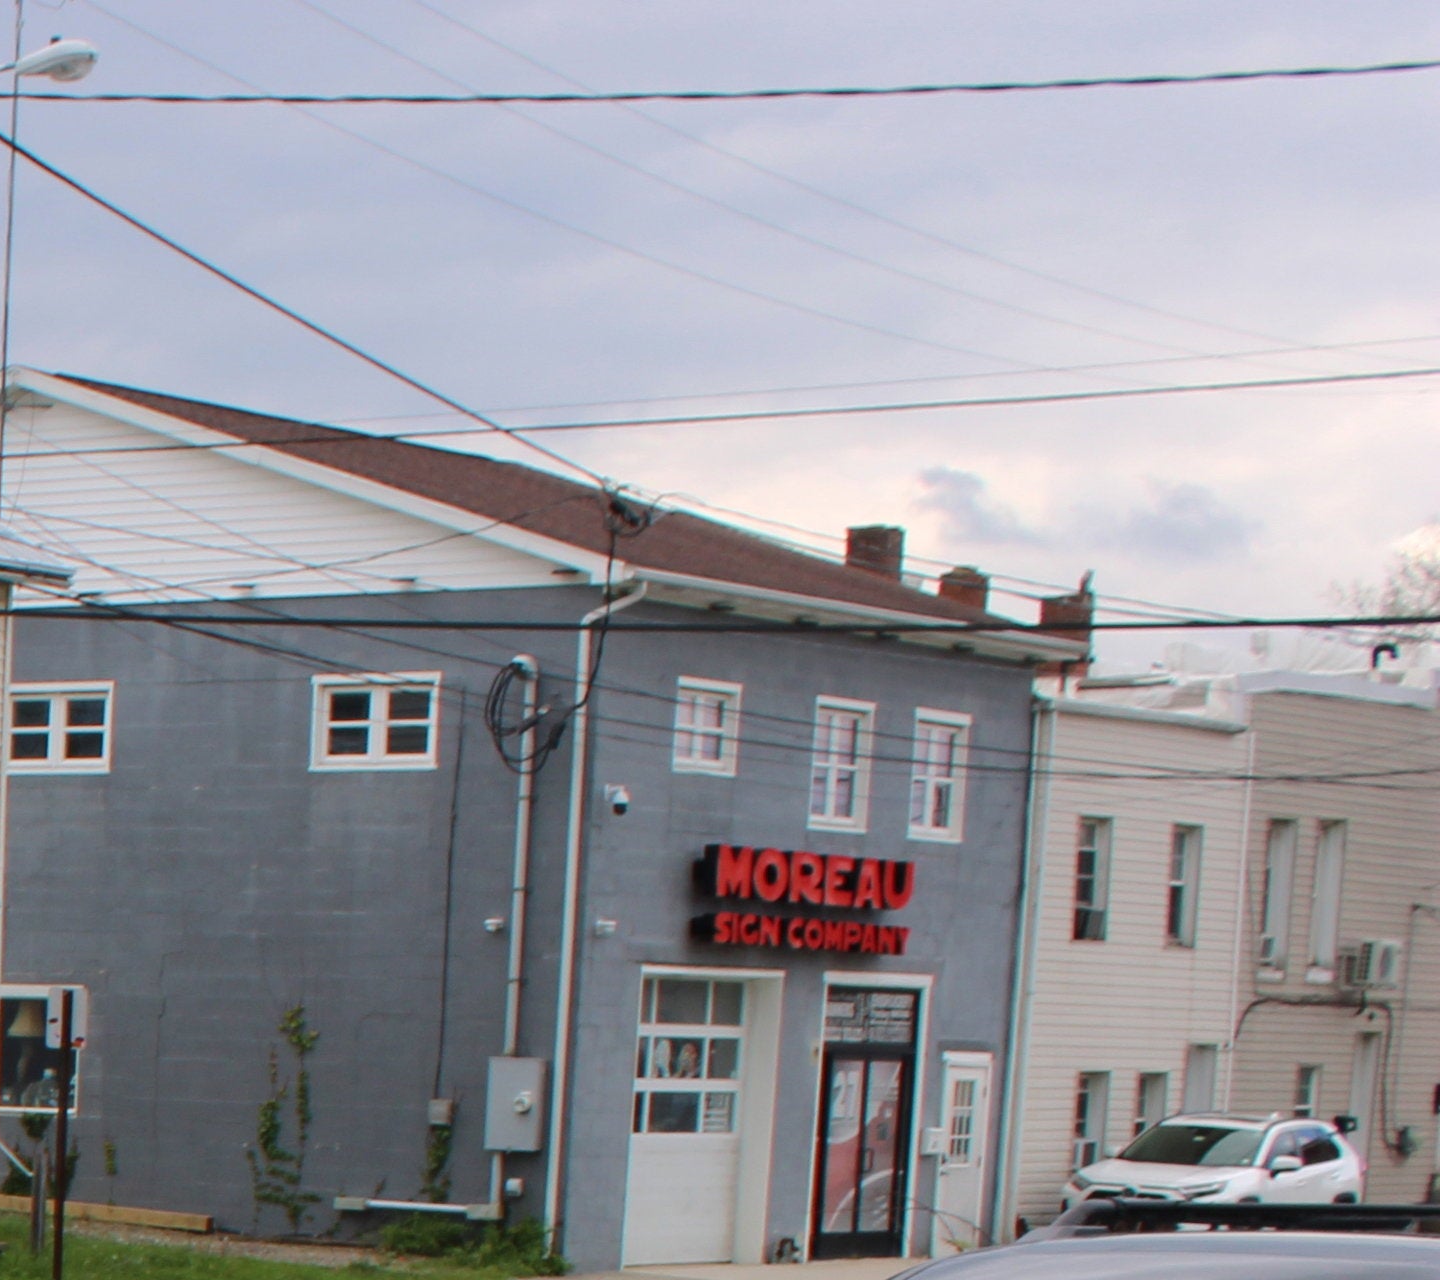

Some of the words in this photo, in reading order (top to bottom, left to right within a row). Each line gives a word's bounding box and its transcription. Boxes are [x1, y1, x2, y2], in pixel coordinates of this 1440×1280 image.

[715, 844, 916, 911] MOREAU
[714, 911, 782, 946] SIGN
[787, 917, 912, 955] COMPANY
